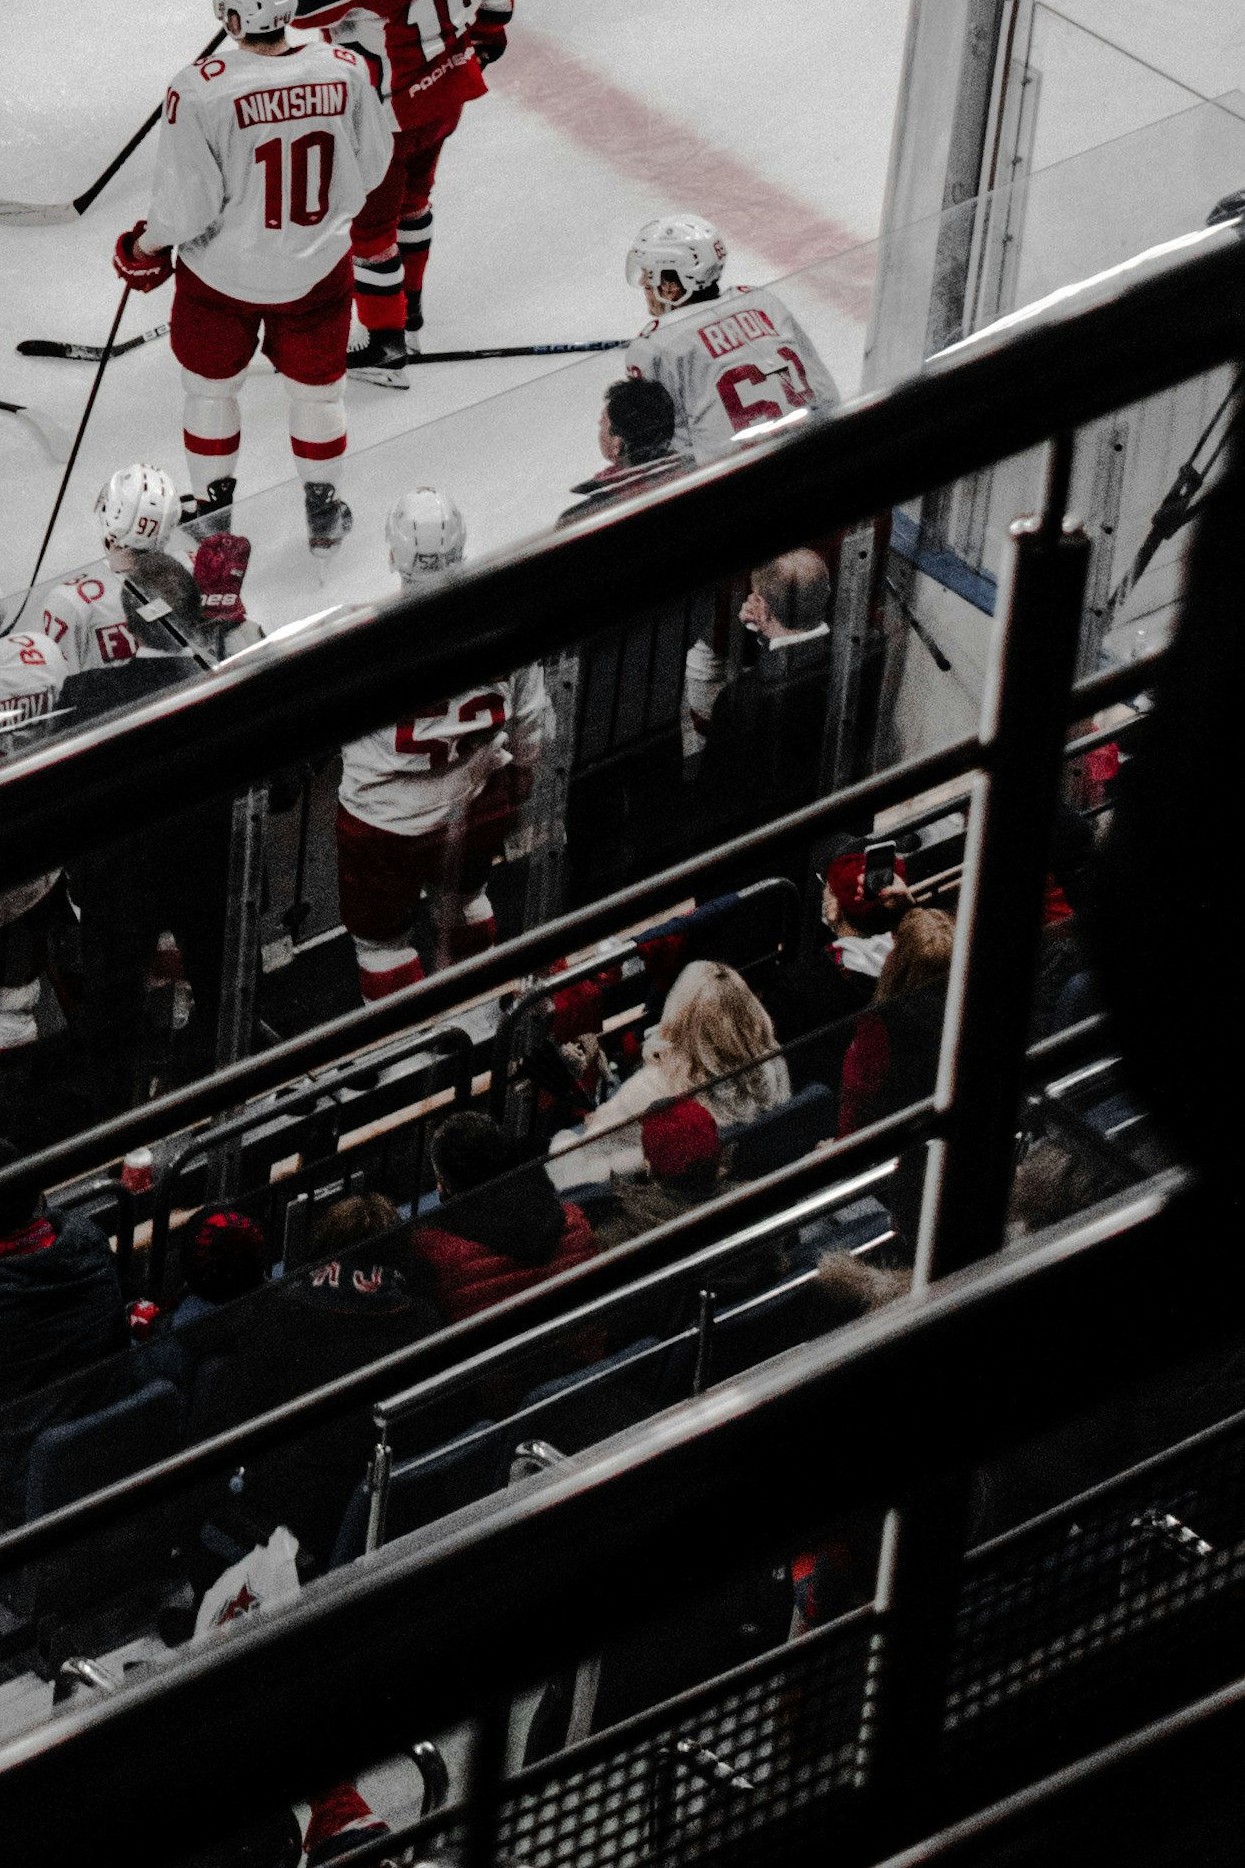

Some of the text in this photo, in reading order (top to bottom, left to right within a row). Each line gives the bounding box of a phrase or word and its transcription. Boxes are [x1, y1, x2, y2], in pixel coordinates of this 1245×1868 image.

[239, 83, 345, 126] NIKISHIN
[254, 130, 336, 230] 10
[136, 517, 160, 539] 97
